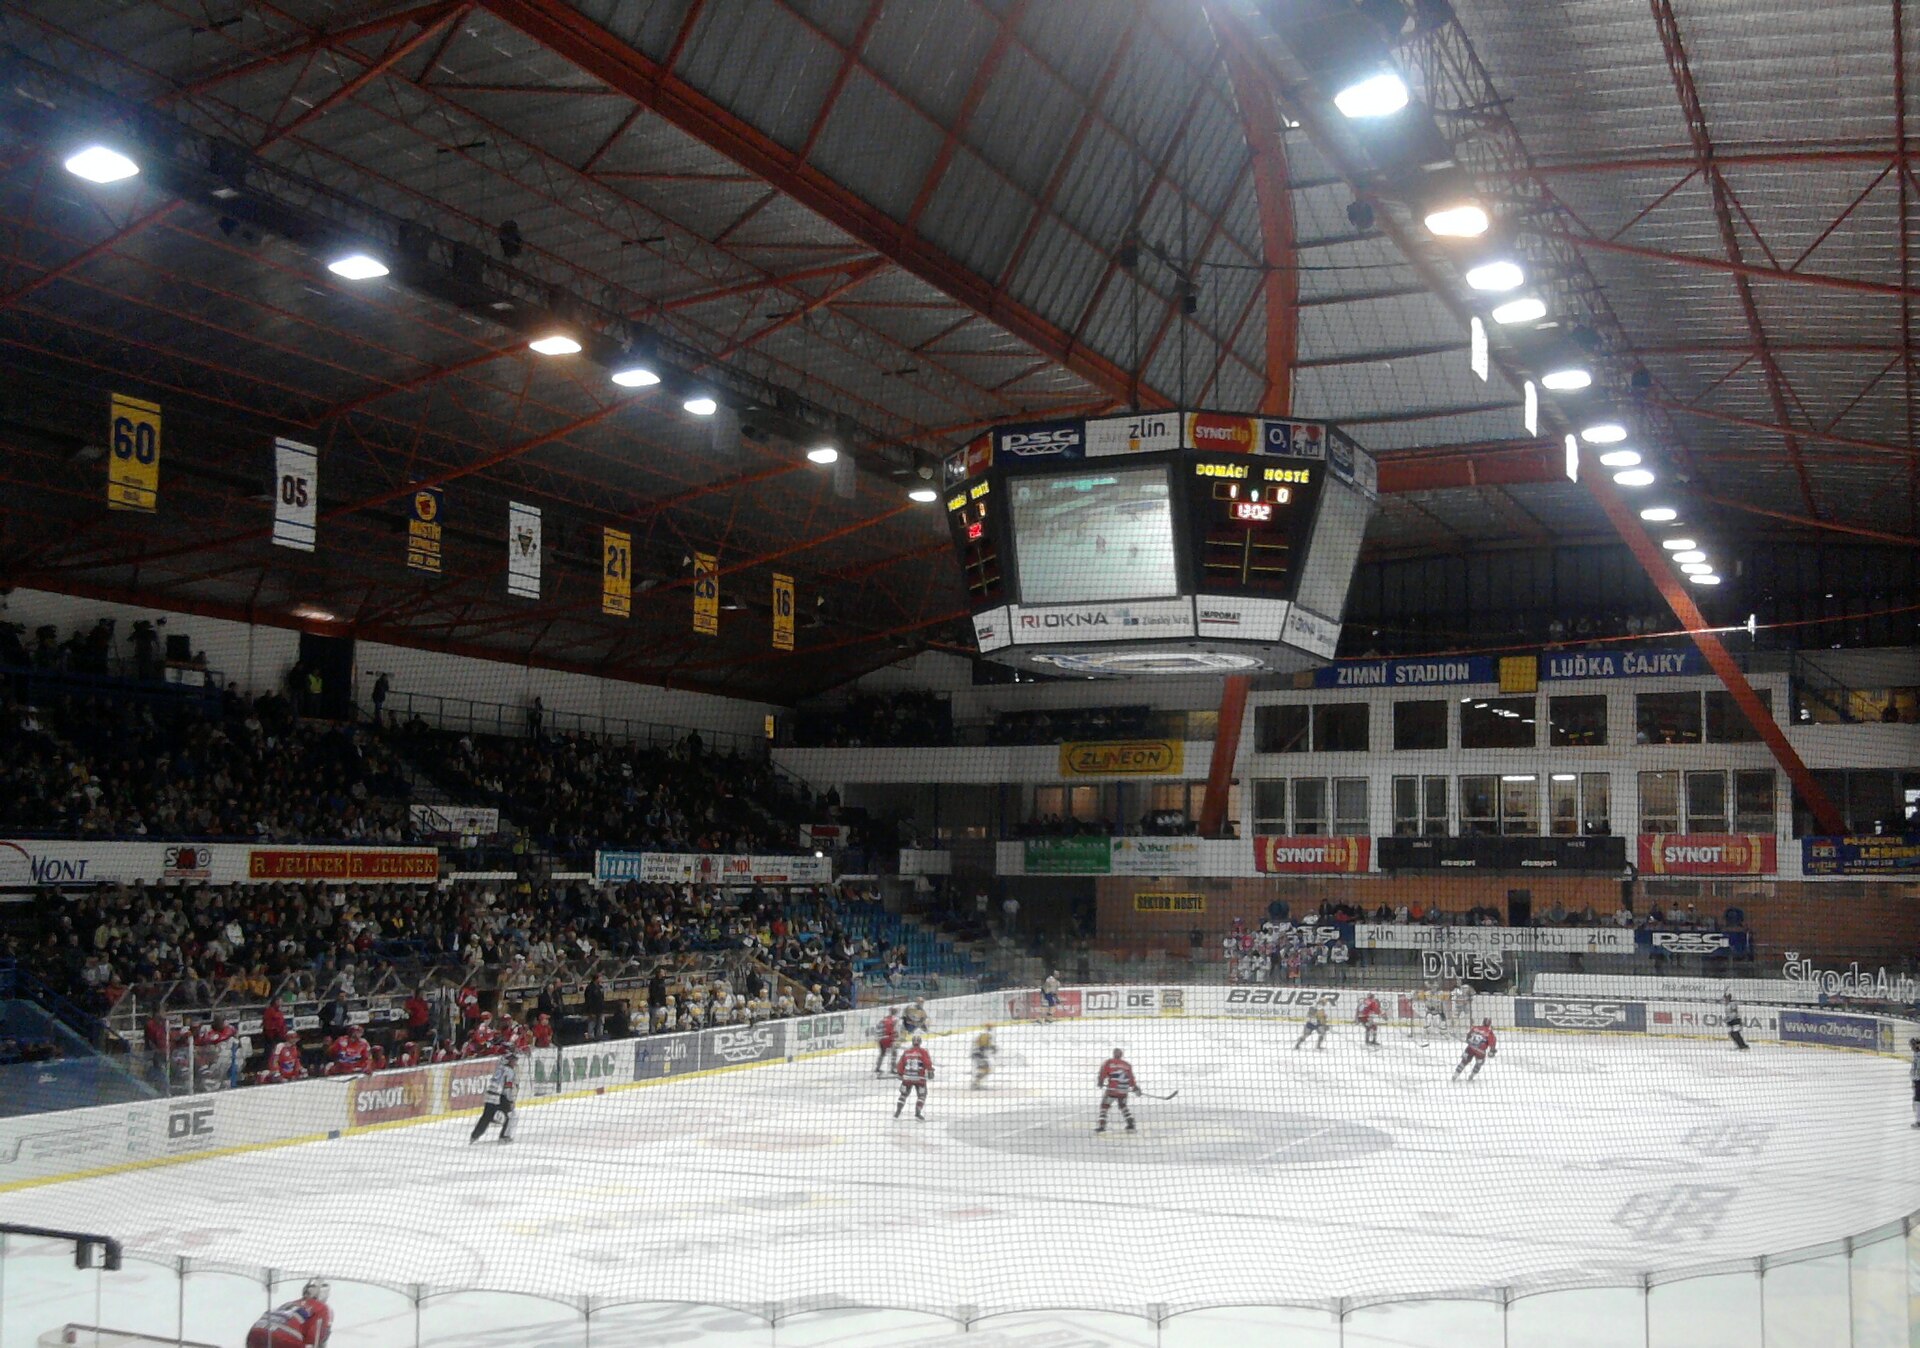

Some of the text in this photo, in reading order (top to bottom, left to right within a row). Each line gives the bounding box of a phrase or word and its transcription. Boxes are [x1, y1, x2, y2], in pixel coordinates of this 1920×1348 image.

[115, 417, 155, 464] 60
[1002, 429, 1078, 450] PSG
[1196, 463, 1310, 483] DOMÁCÍ HOSTÉ
[282, 475, 308, 507] 05
[607, 545, 626, 579] 21
[776, 588, 791, 617] 16
[1044, 612, 1108, 628] OKNA
[1336, 661, 1469, 685] ZIMNÍ STADION
[1549, 650, 1685, 677] LUĎKA ČAJKY
[1489, 931, 1564, 950] sportu
[1652, 932, 1729, 947] PSG
[1422, 950, 1503, 981] DNES
[714, 1027, 774, 1054] PSG
